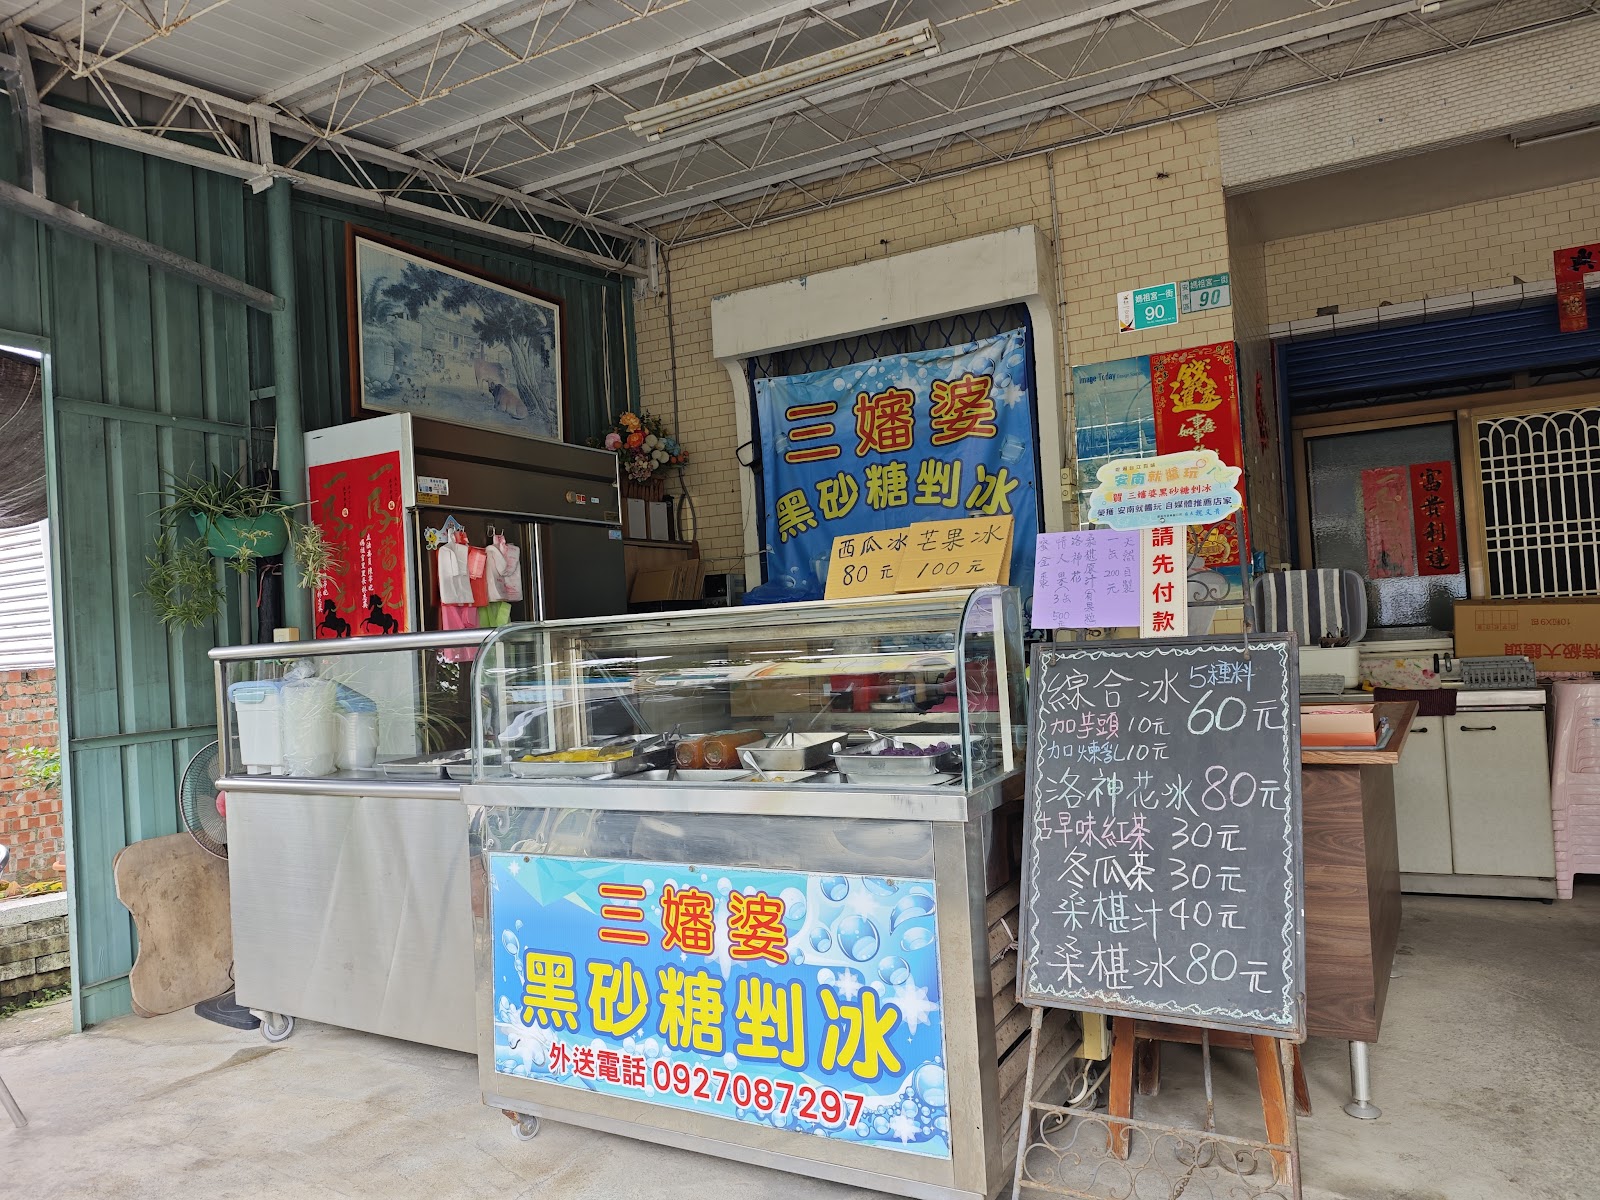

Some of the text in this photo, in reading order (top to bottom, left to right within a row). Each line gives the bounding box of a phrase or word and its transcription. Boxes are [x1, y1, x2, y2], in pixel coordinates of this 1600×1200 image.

[1135, 289, 1174, 304] 媽祖宮一街
[1190, 276, 1228, 290] 媽祖宮一街
[1199, 289, 1221, 307] 90
[1145, 304, 1165, 321] 90
[785, 373, 997, 464] 三嬸婆
[776, 459, 1018, 542] 黑砂糖剉冰
[838, 533, 907, 559] 西瓜冰
[917, 524, 1005, 551] 芒果冰
[1152, 526, 1175, 632] 請先付款
[1047, 659, 1255, 711] 綜合冰 5種料
[1057, 846, 1156, 892] 冬瓜茶
[597, 882, 790, 964] 三嬸婆
[522, 952, 903, 1080] 黑砂糖剉冰
[549, 1042, 864, 1128] 外送電話 0927087297
